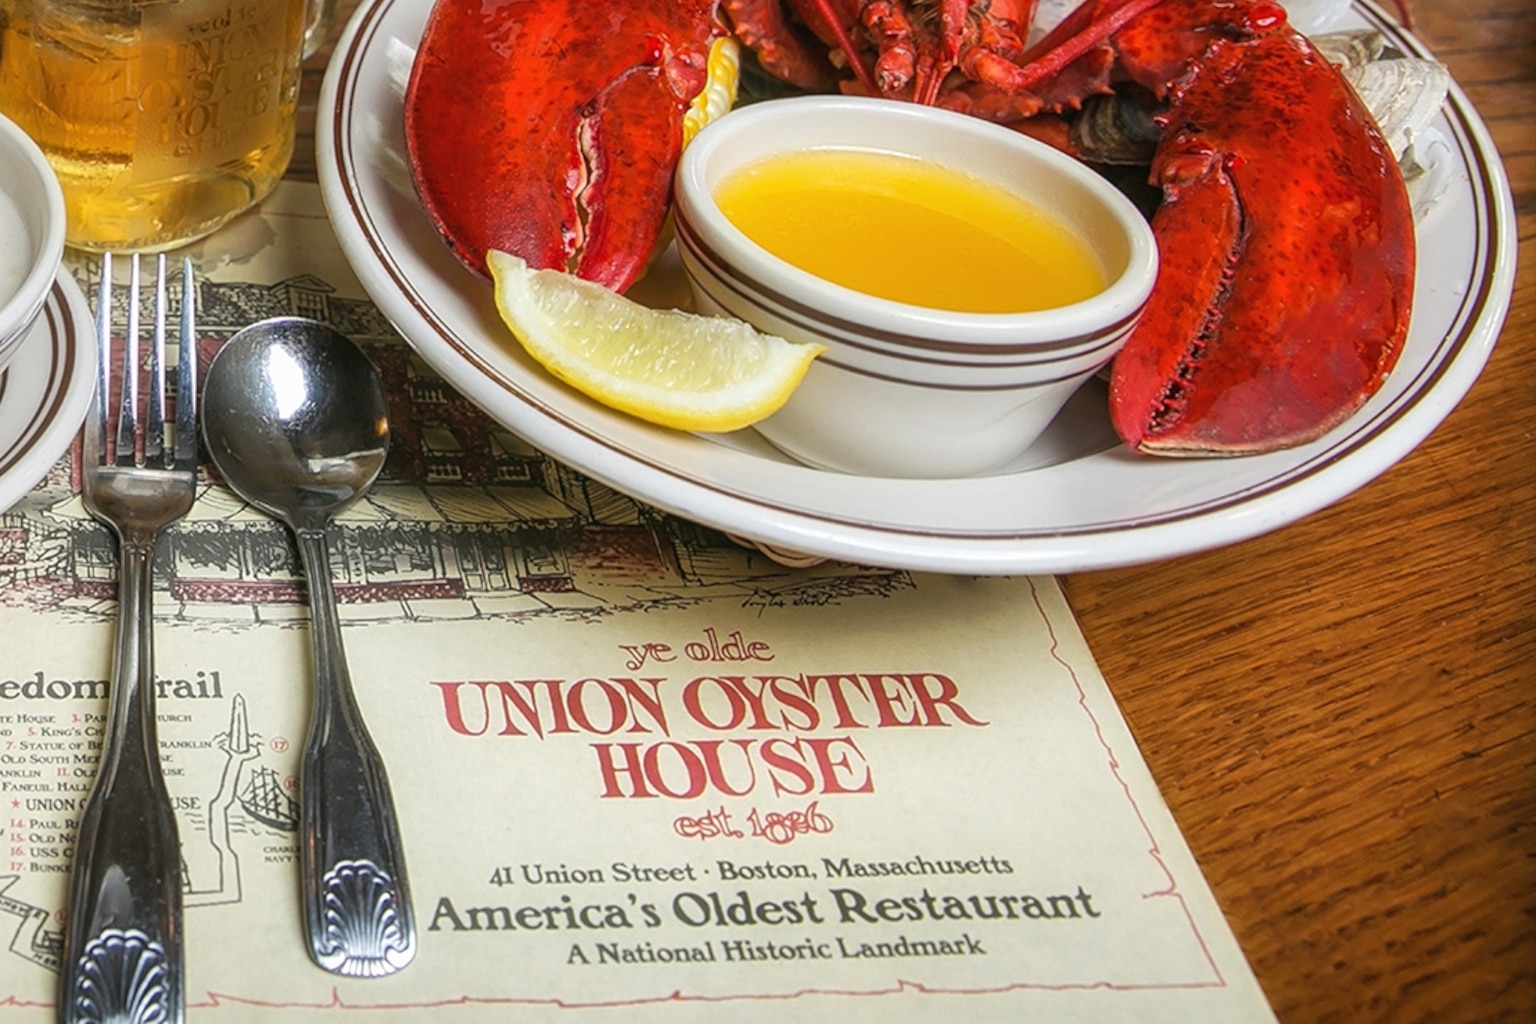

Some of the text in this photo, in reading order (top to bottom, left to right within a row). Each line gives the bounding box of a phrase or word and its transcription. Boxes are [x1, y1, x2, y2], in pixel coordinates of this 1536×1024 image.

[620, 628, 775, 672] ye olde
[154, 670, 224, 699] rail
[429, 671, 991, 741] UNION OYSTER
[16, 713, 57, 724] HOUSE
[71, 713, 81, 724] 3.
[84, 713, 107, 724] PAR
[5, 740, 15, 751] 7.
[19, 740, 66, 752] STATUE
[159, 740, 212, 749] RANKLIN
[0, 754, 27, 765] OLD
[29, 753, 70, 765] SOUTH
[588, 735, 876, 800] HOUSE
[1, 781, 54, 793] FANEUIL
[25, 798, 76, 812] UNION
[171, 796, 202, 810] USE
[29, 818, 61, 830] PAUL
[673, 802, 834, 845] est. 1826
[29, 832, 56, 844] OLD
[29, 847, 60, 858] USS
[29, 861, 73, 874] BUNKE
[488, 853, 1014, 888] 41 Union Street Boston, Massachusetts
[427, 885, 1102, 934] America's Oldest Restaurant
[567, 932, 987, 966] A National Historic Landmark
